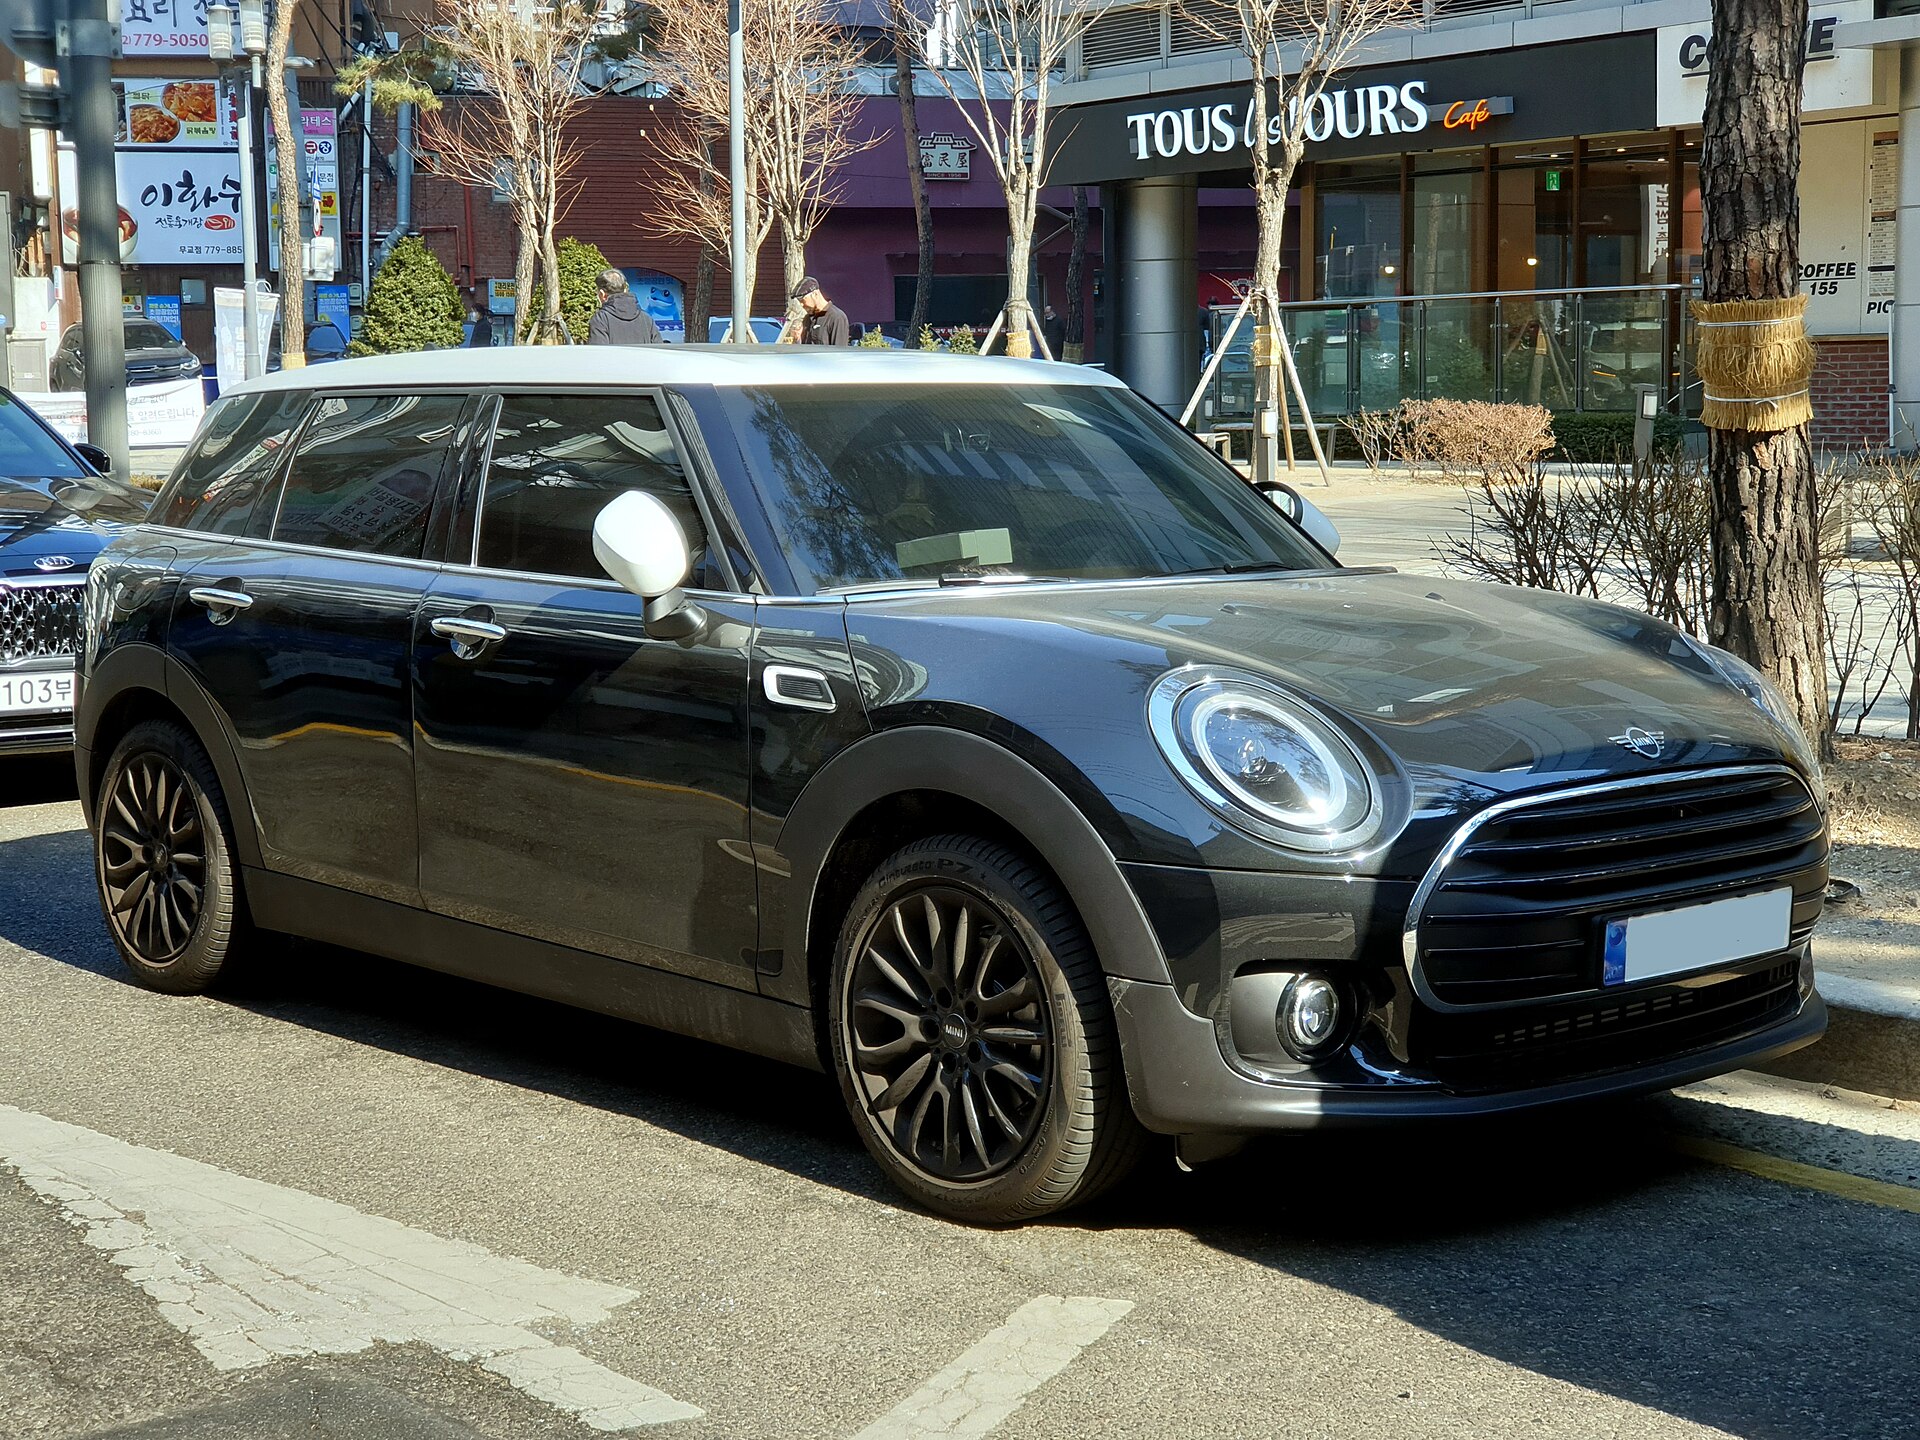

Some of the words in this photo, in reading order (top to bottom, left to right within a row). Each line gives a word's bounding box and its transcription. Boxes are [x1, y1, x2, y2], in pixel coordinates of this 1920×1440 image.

[1127, 104, 1236, 160] TOUS
[1244, 98, 1281, 145] ls
[1444, 99, 1491, 130] Café
[155, 215, 203, 229] 전통육개장
[179, 245, 202, 255] 무교점
[1810, 281, 1838, 295] 155
[2, 679, 72, 706] 103부
[937, 857, 974, 874] P7
[944, 1024, 963, 1038] MINI
